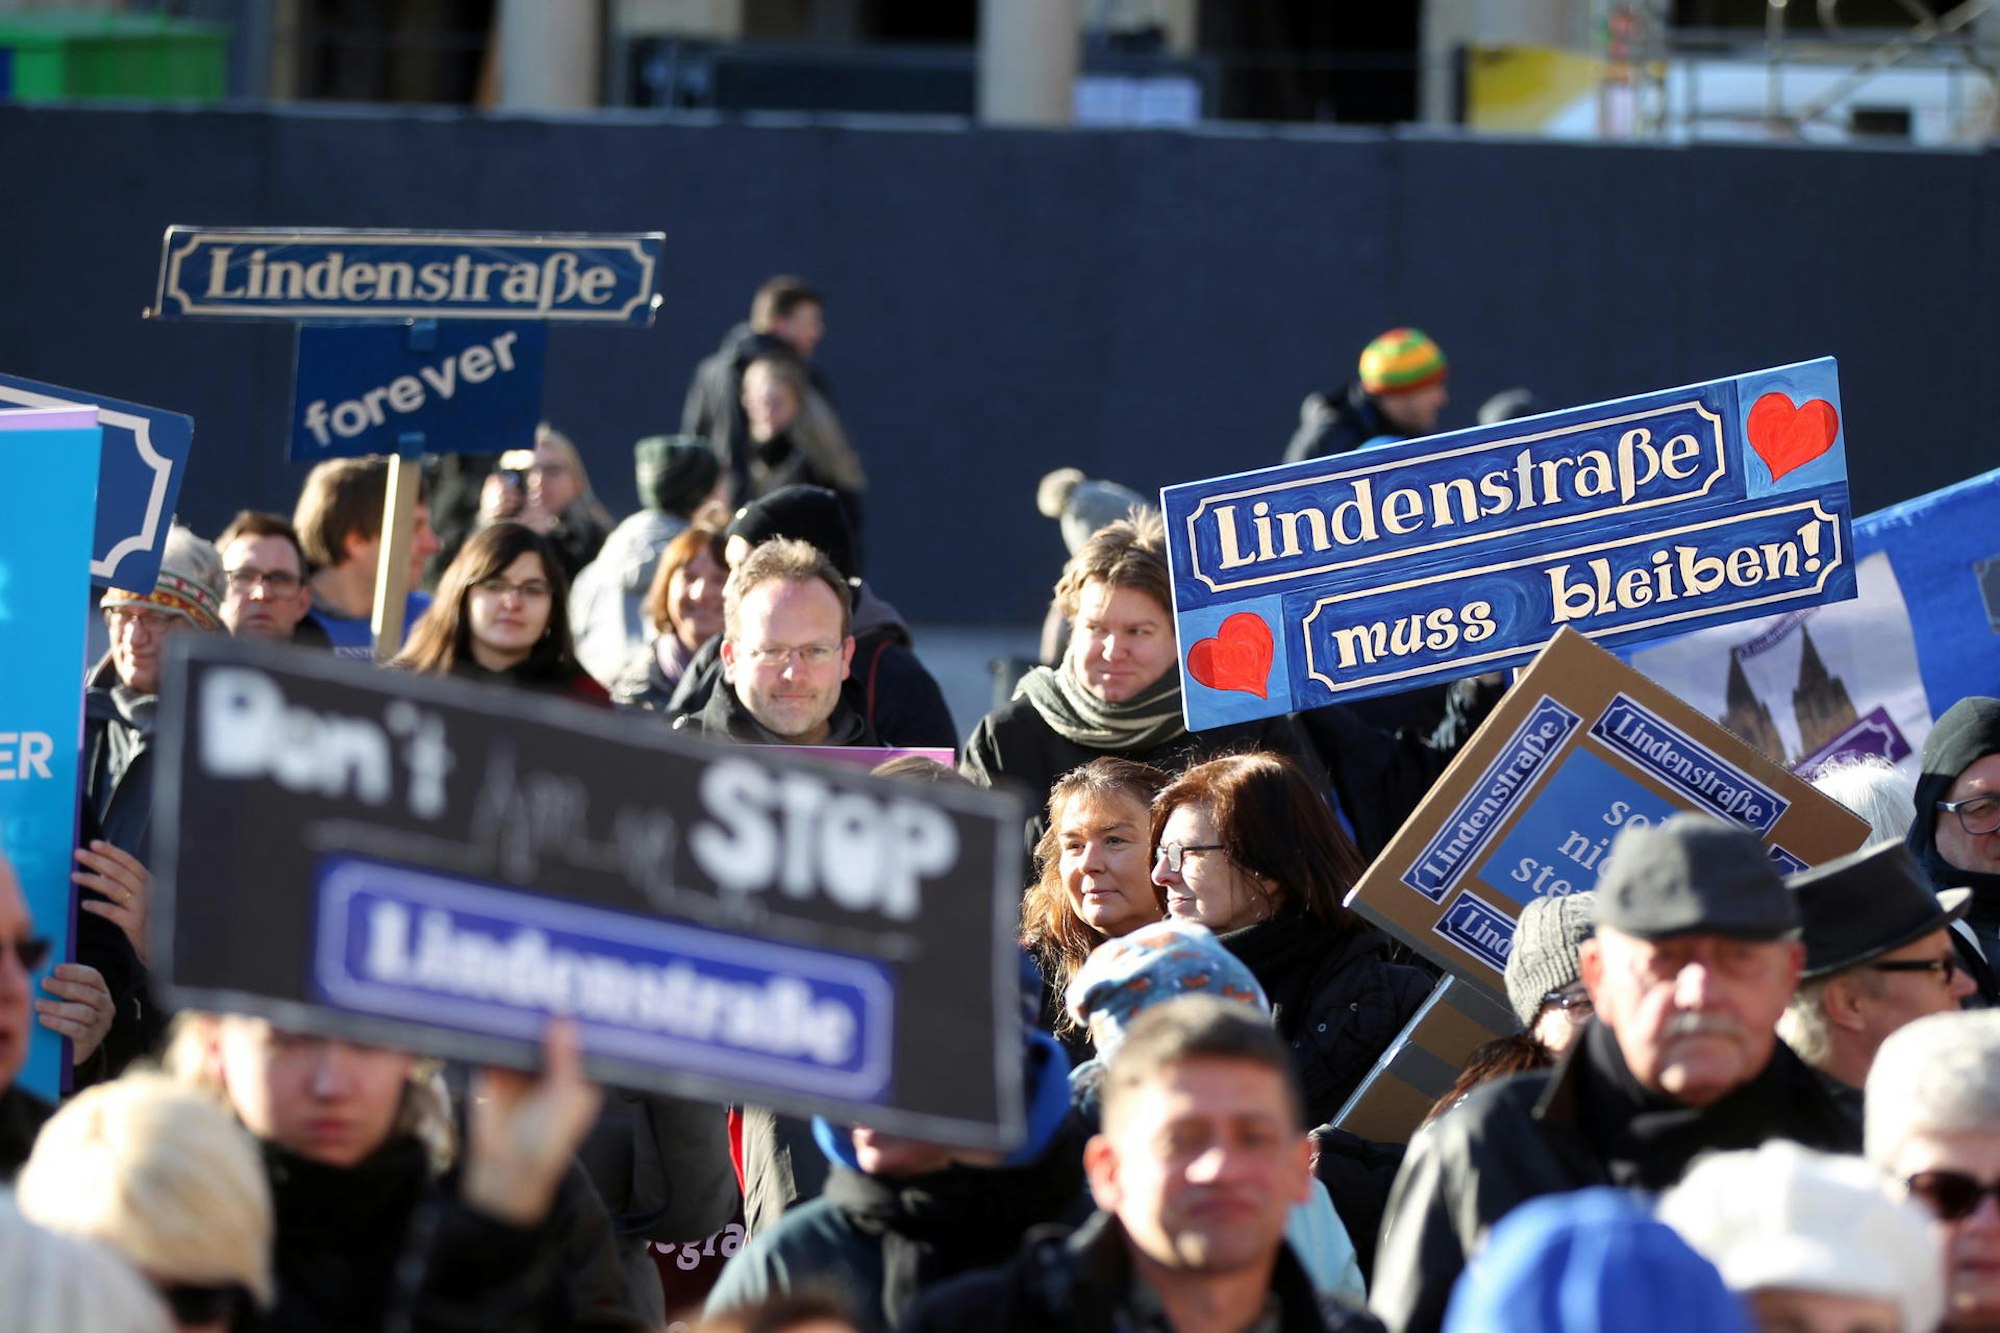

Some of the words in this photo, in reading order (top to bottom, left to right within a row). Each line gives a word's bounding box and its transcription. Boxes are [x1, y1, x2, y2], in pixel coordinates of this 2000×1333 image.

[203, 246, 617, 312] Lindenstraße
[304, 331, 518, 447] forever
[1214, 428, 1700, 570] Lindenstraße
[1331, 600, 1498, 669] muss
[1544, 520, 1821, 625] bleiben!
[0, 730, 54, 781] ER
[1423, 720, 1559, 881] Lindenstraße
[1613, 712, 1763, 823] Lindenstraße
[690, 757, 958, 920] STOP
[1510, 857, 1581, 900] ste
[366, 899, 859, 1067] Lindenstraße
